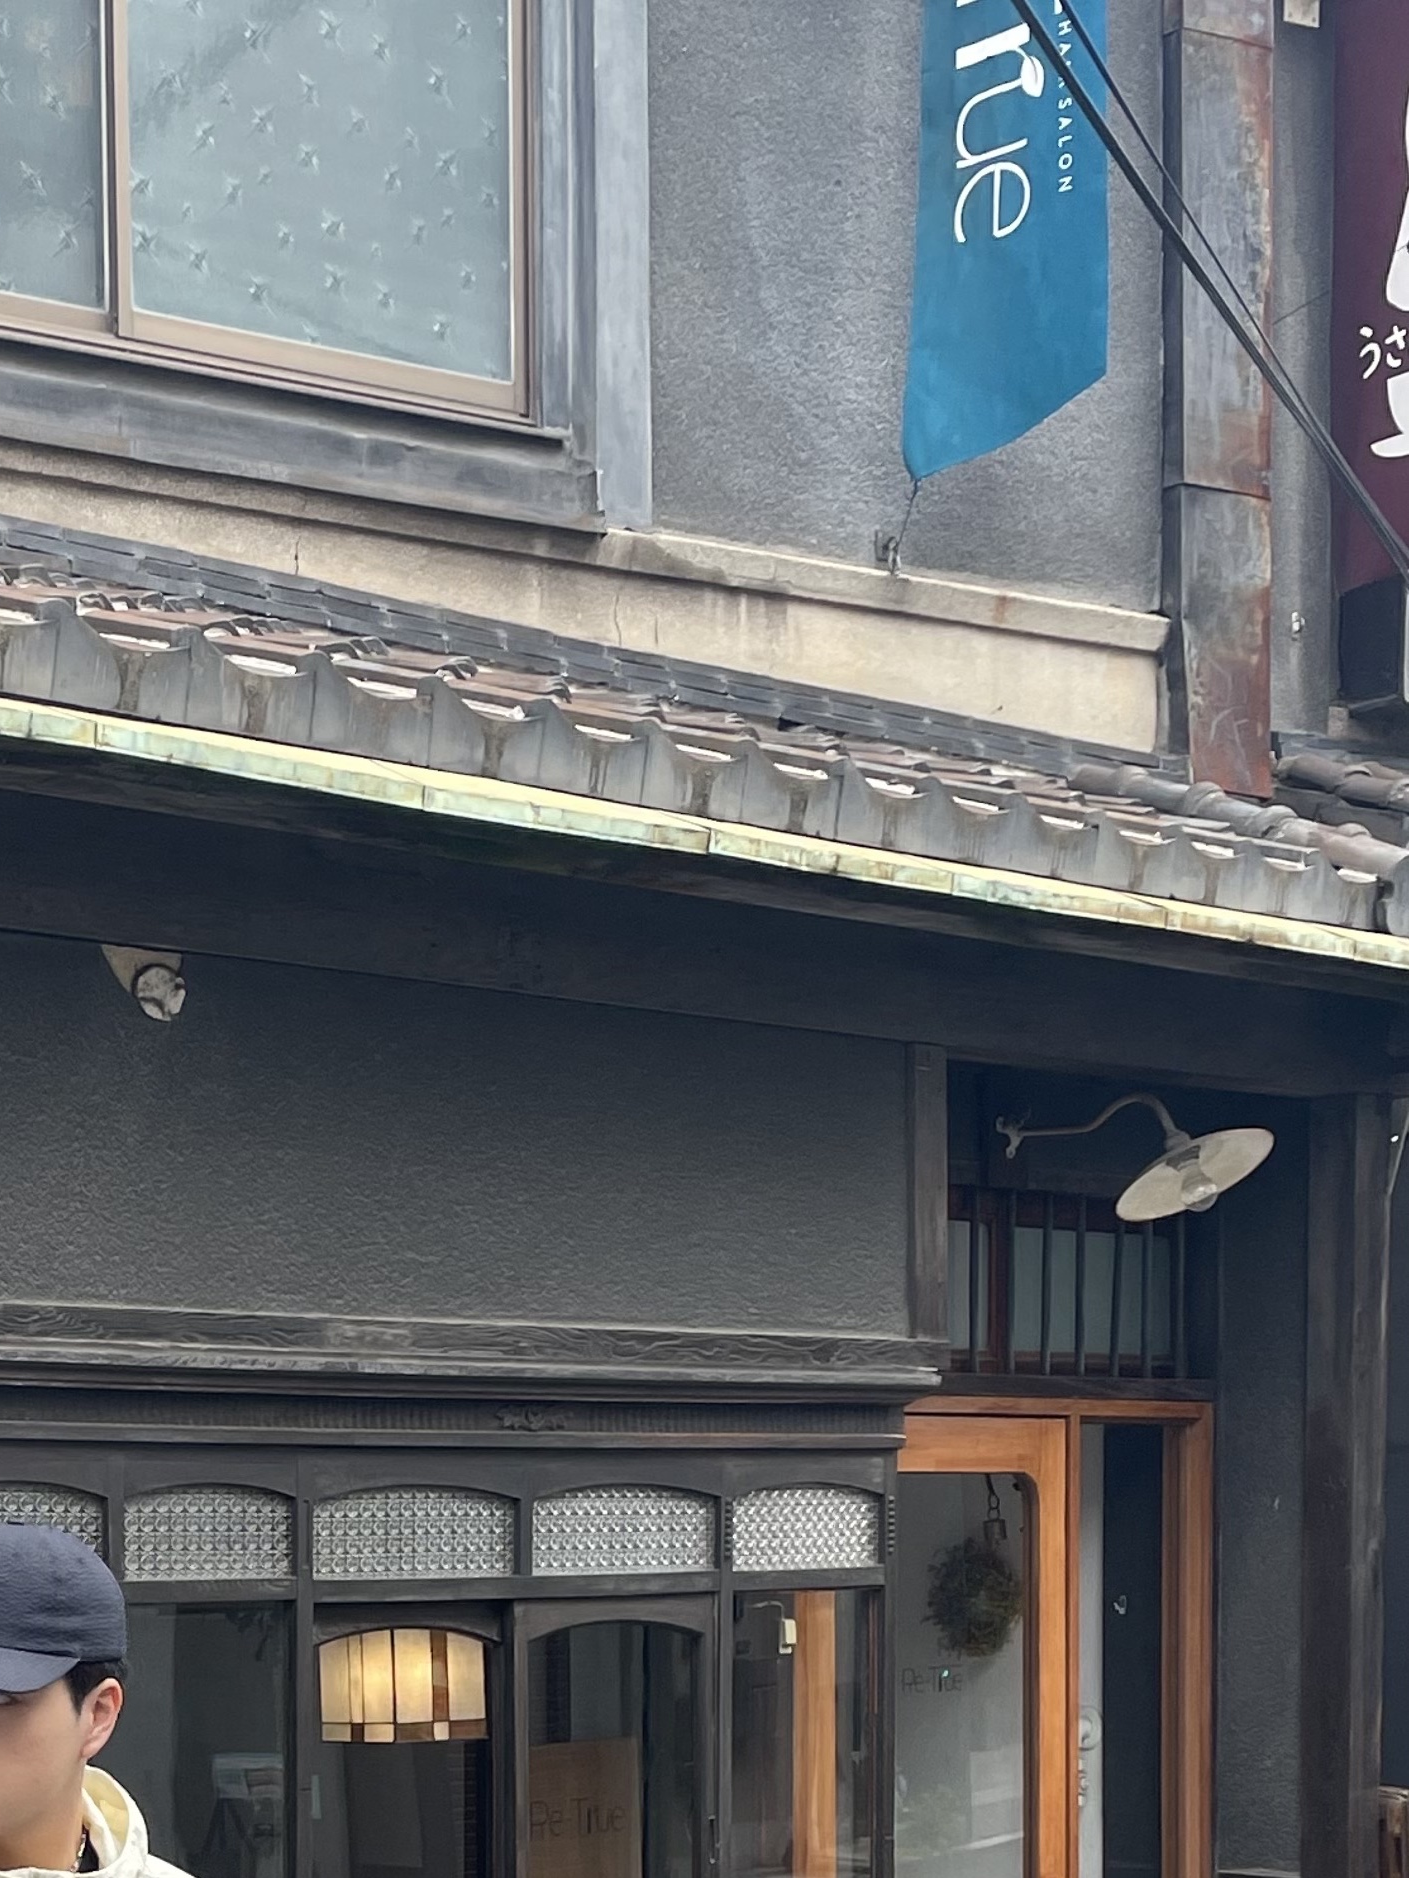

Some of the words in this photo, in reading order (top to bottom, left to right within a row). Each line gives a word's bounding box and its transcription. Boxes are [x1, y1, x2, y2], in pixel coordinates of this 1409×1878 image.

[1058, 20, 1072, 89] HA
[955, 0, 1063, 242] rue
[1058, 97, 1073, 193] SALON
